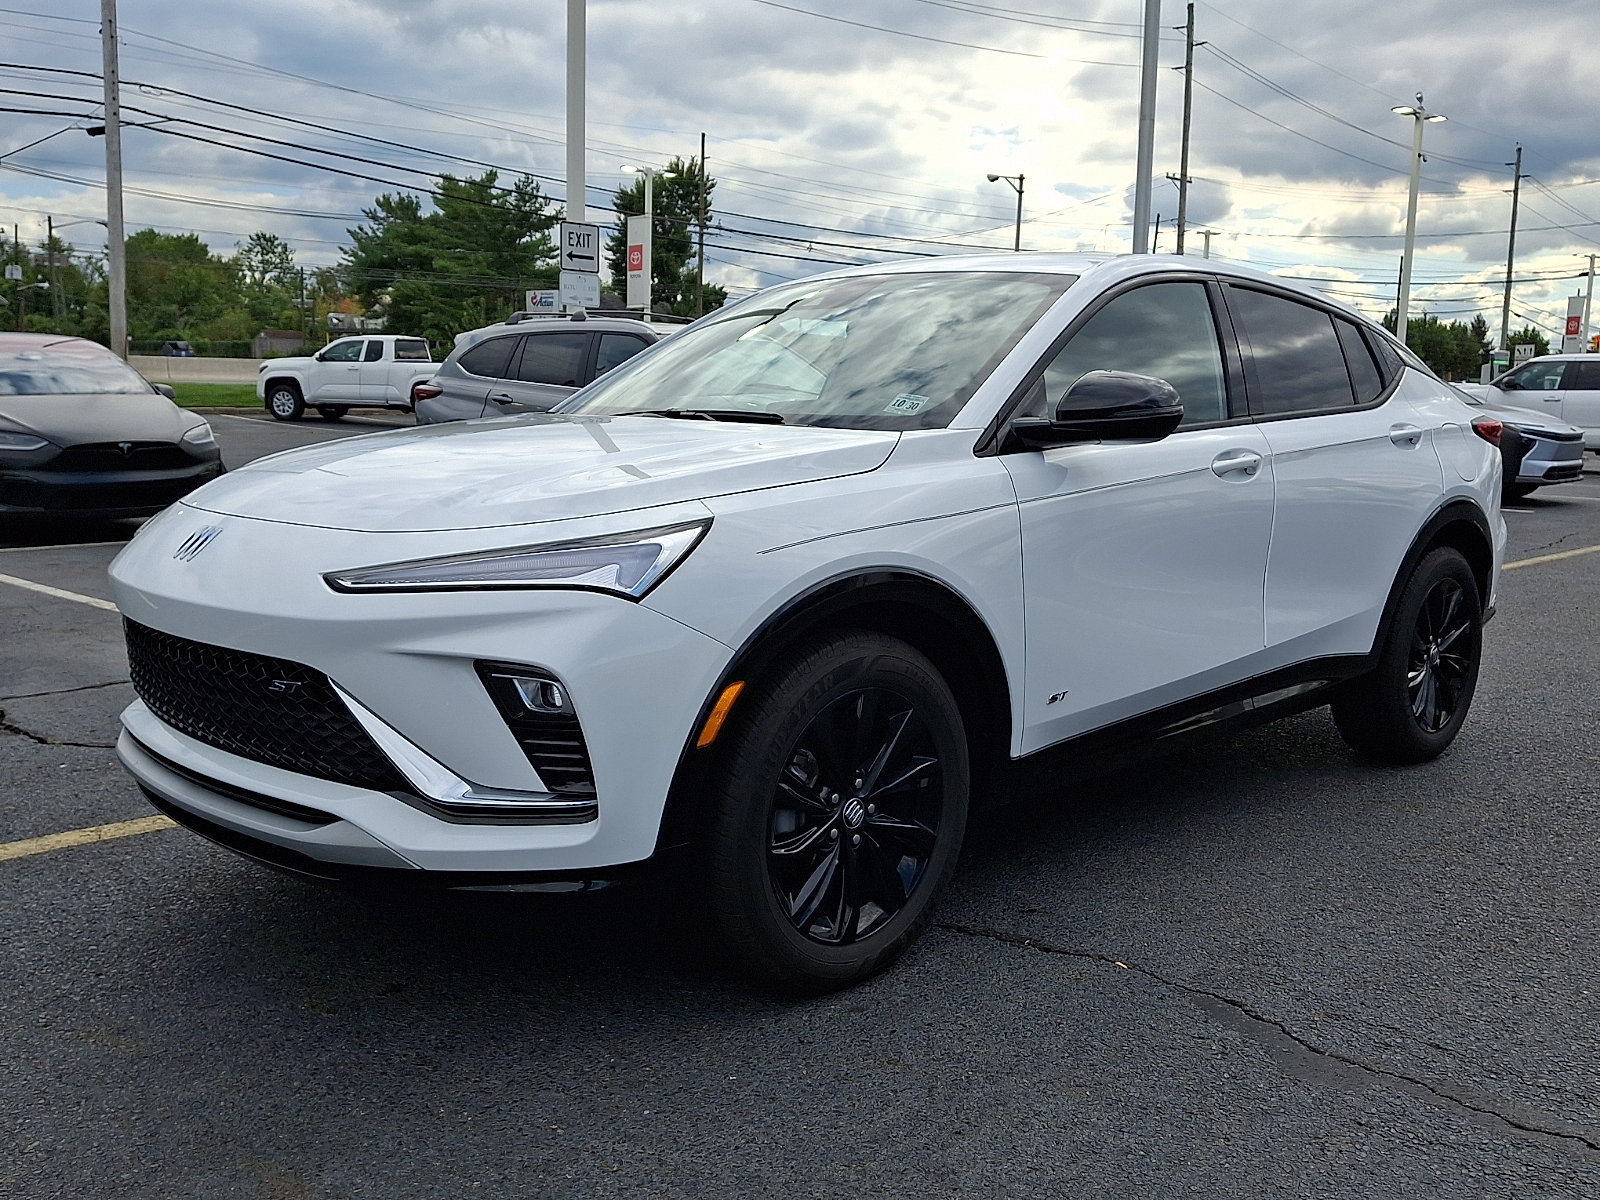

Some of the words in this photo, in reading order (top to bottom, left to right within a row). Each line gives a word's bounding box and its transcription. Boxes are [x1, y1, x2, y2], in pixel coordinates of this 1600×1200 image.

[568, 231, 592, 249] EXIT
[891, 399, 907, 407] 10
[905, 402, 920, 410] 30
[268, 679, 302, 694] ST
[1046, 690, 1069, 705] ST
